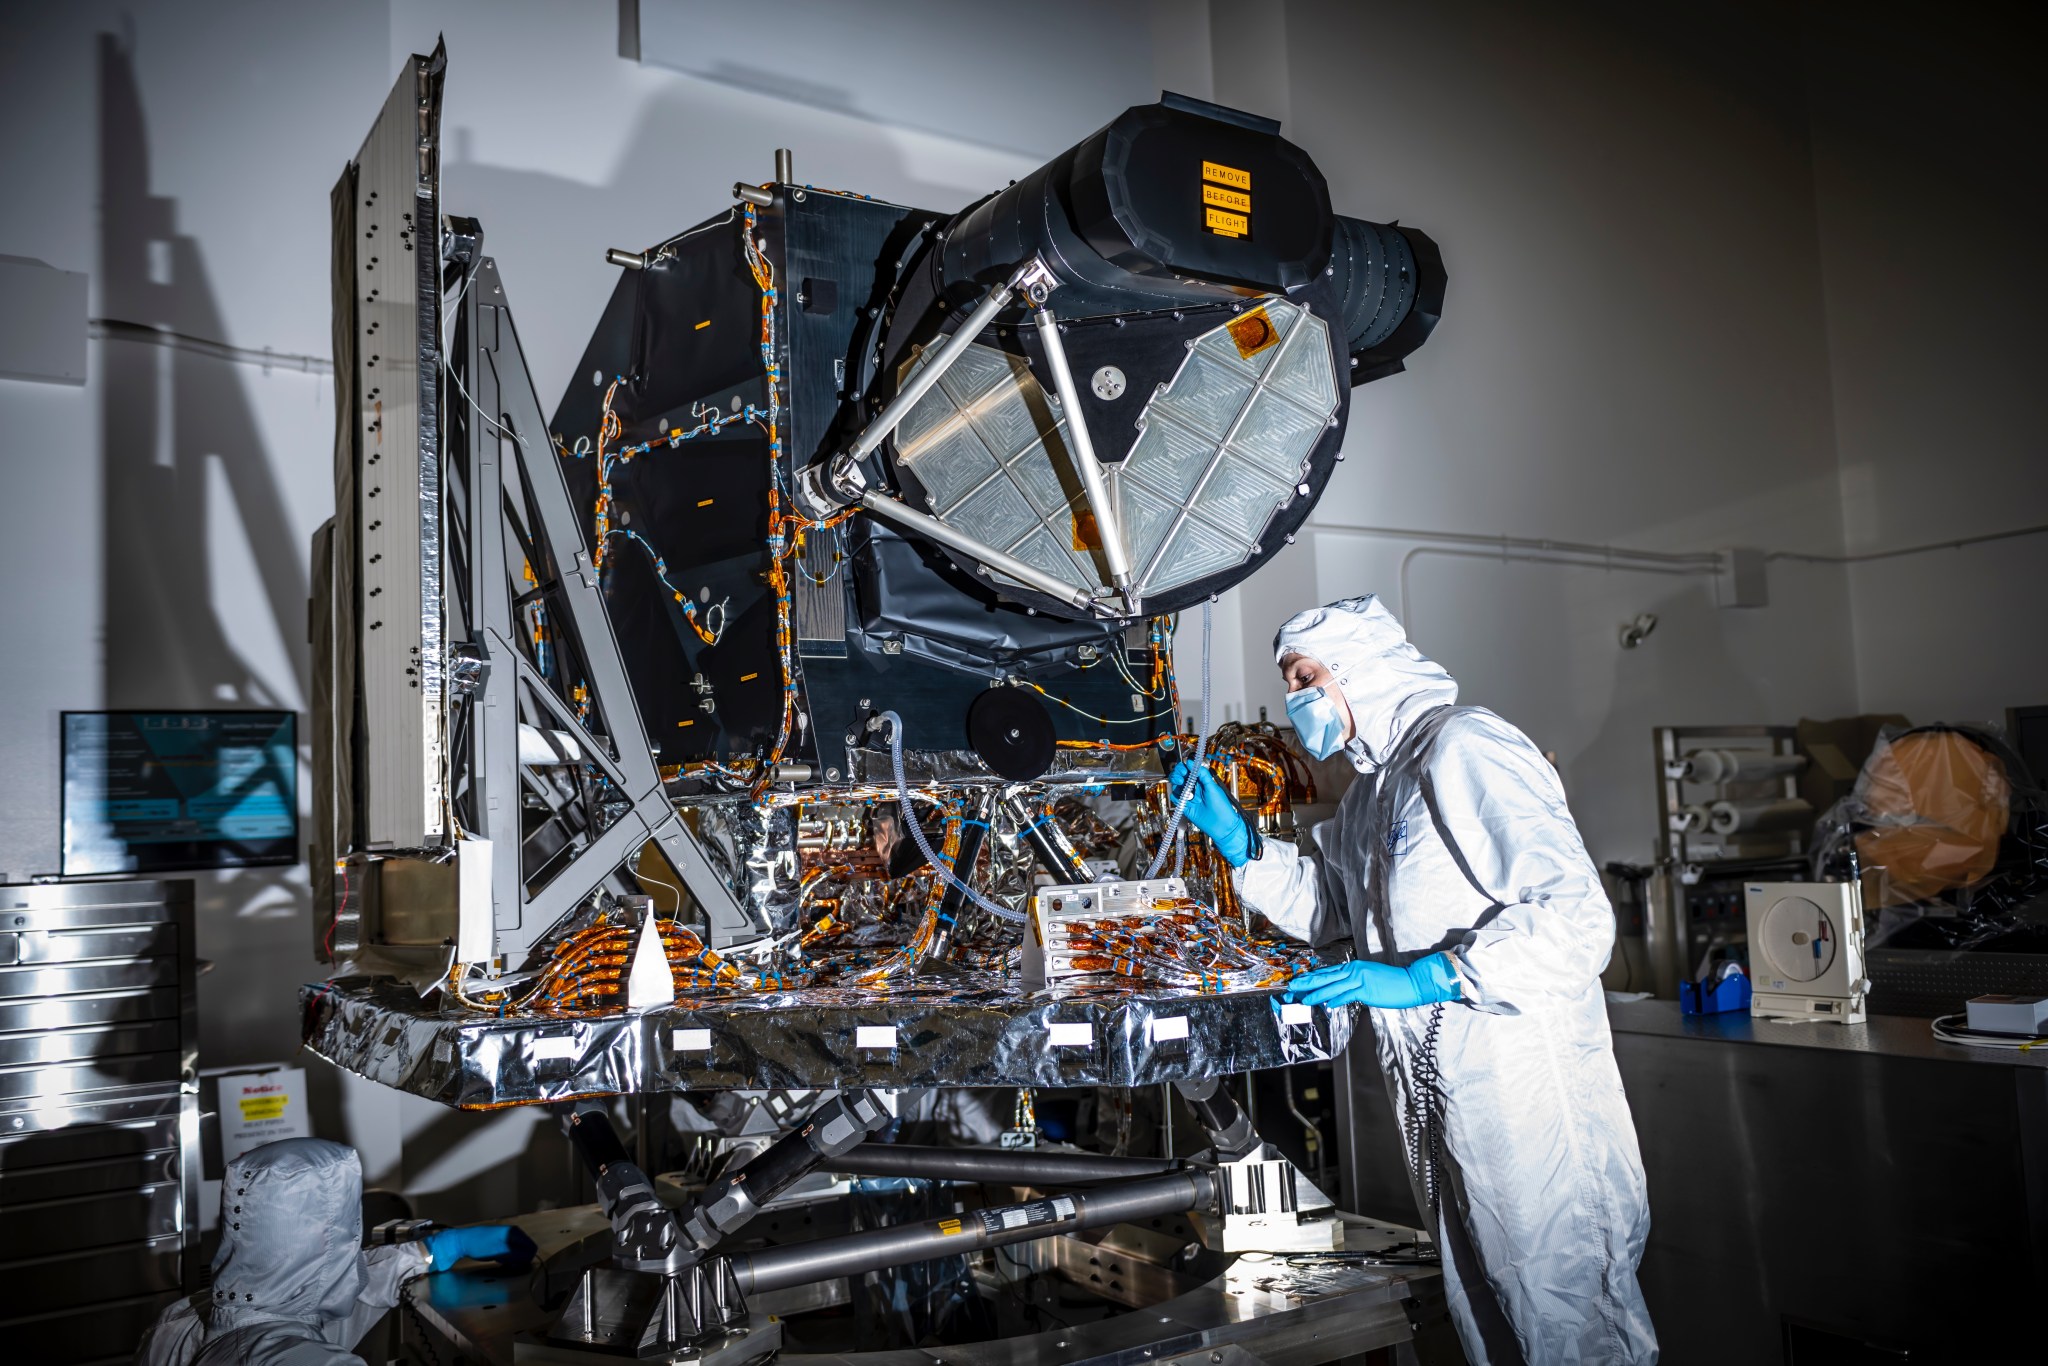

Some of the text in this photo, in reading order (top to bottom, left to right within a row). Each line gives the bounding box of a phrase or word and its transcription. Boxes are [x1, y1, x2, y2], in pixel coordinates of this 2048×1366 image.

[1205, 166, 1247, 185] REMOVE
[1206, 190, 1246, 207] BEFORE
[1209, 213, 1246, 229] FLIGHT
